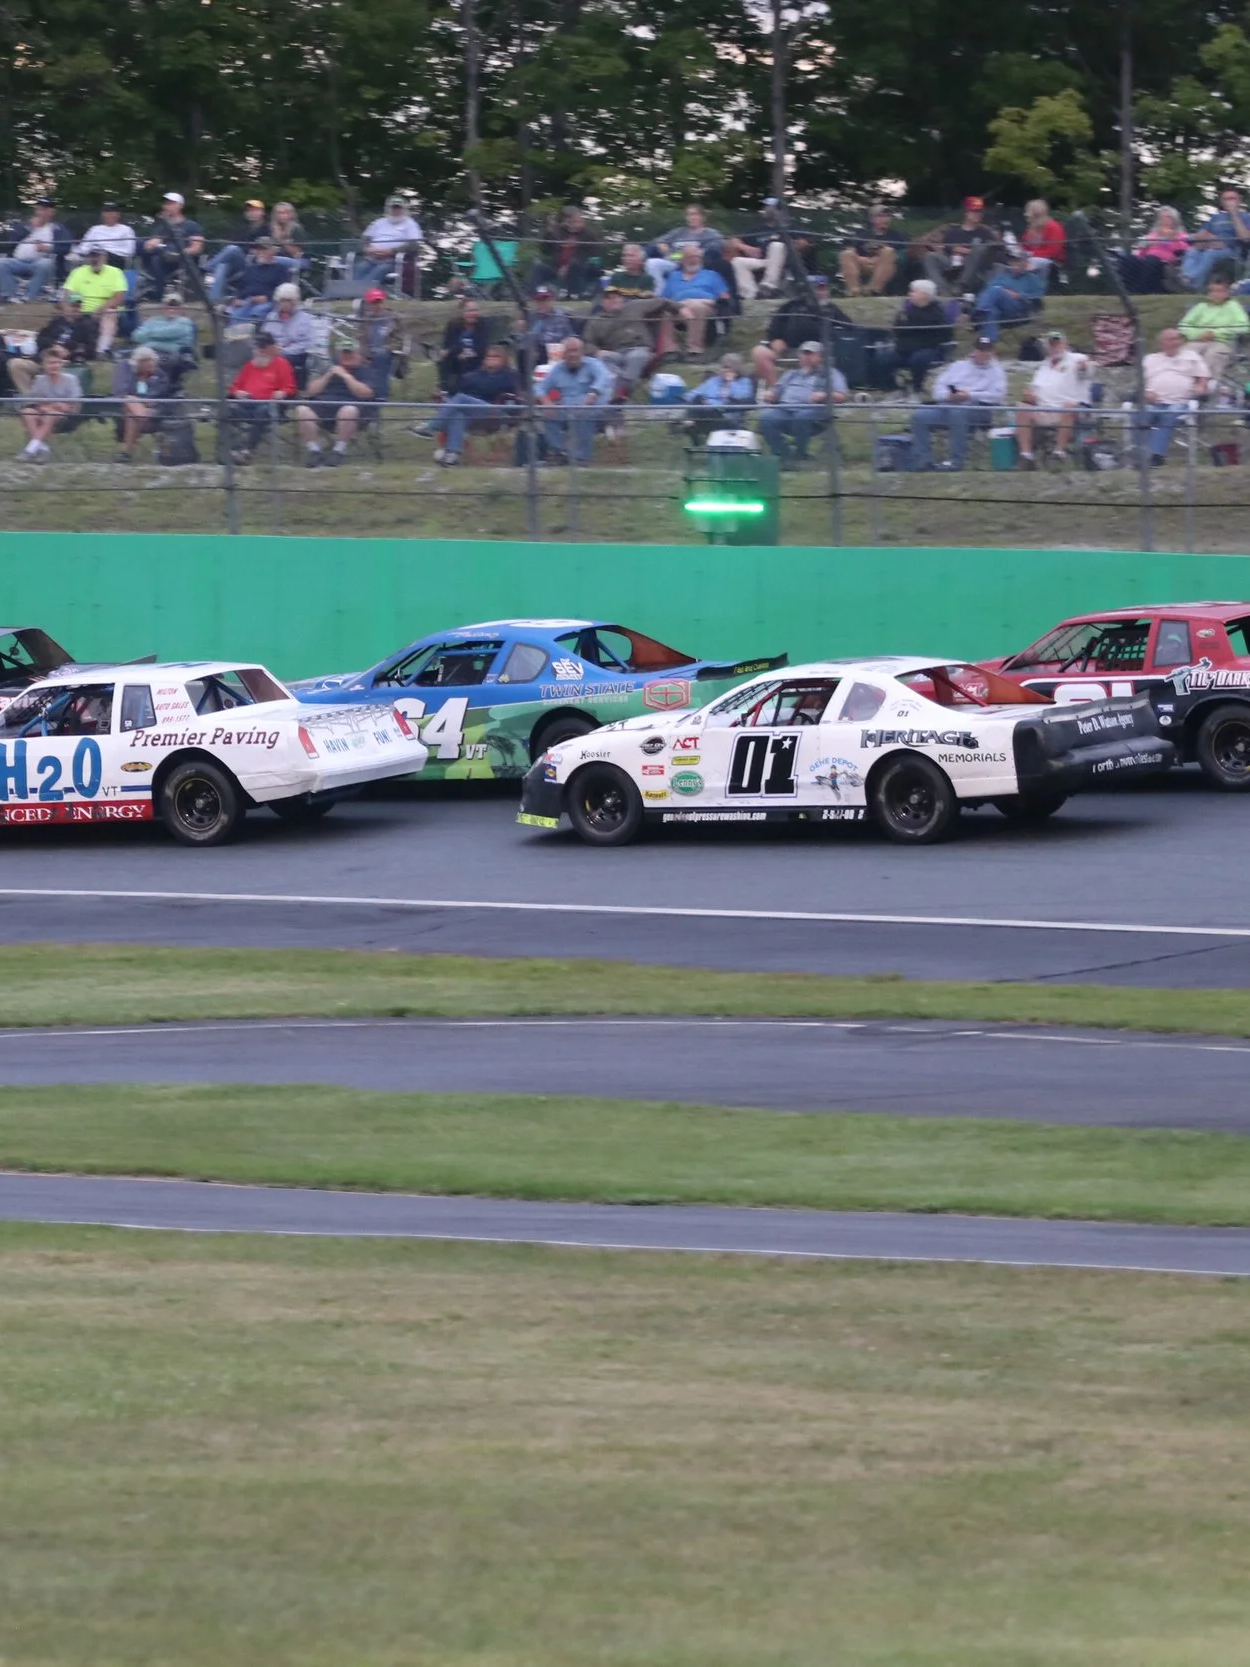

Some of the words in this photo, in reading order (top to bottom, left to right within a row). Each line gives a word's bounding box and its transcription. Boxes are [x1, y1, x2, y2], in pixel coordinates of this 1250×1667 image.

[540, 684, 582, 698] TWIN
[586, 681, 636, 695] STATE
[155, 703, 170, 711] AUTO
[130, 727, 207, 747] Premier
[210, 726, 280, 749] Paving
[672, 736, 700, 751] ACT
[860, 729, 979, 749] HERITAGE
[465, 744, 488, 760] VT
[579, 750, 611, 760] Hoosier
[938, 753, 1007, 763] MEMORIALS
[726, 733, 800, 796] 01
[102, 786, 118, 797] VT
